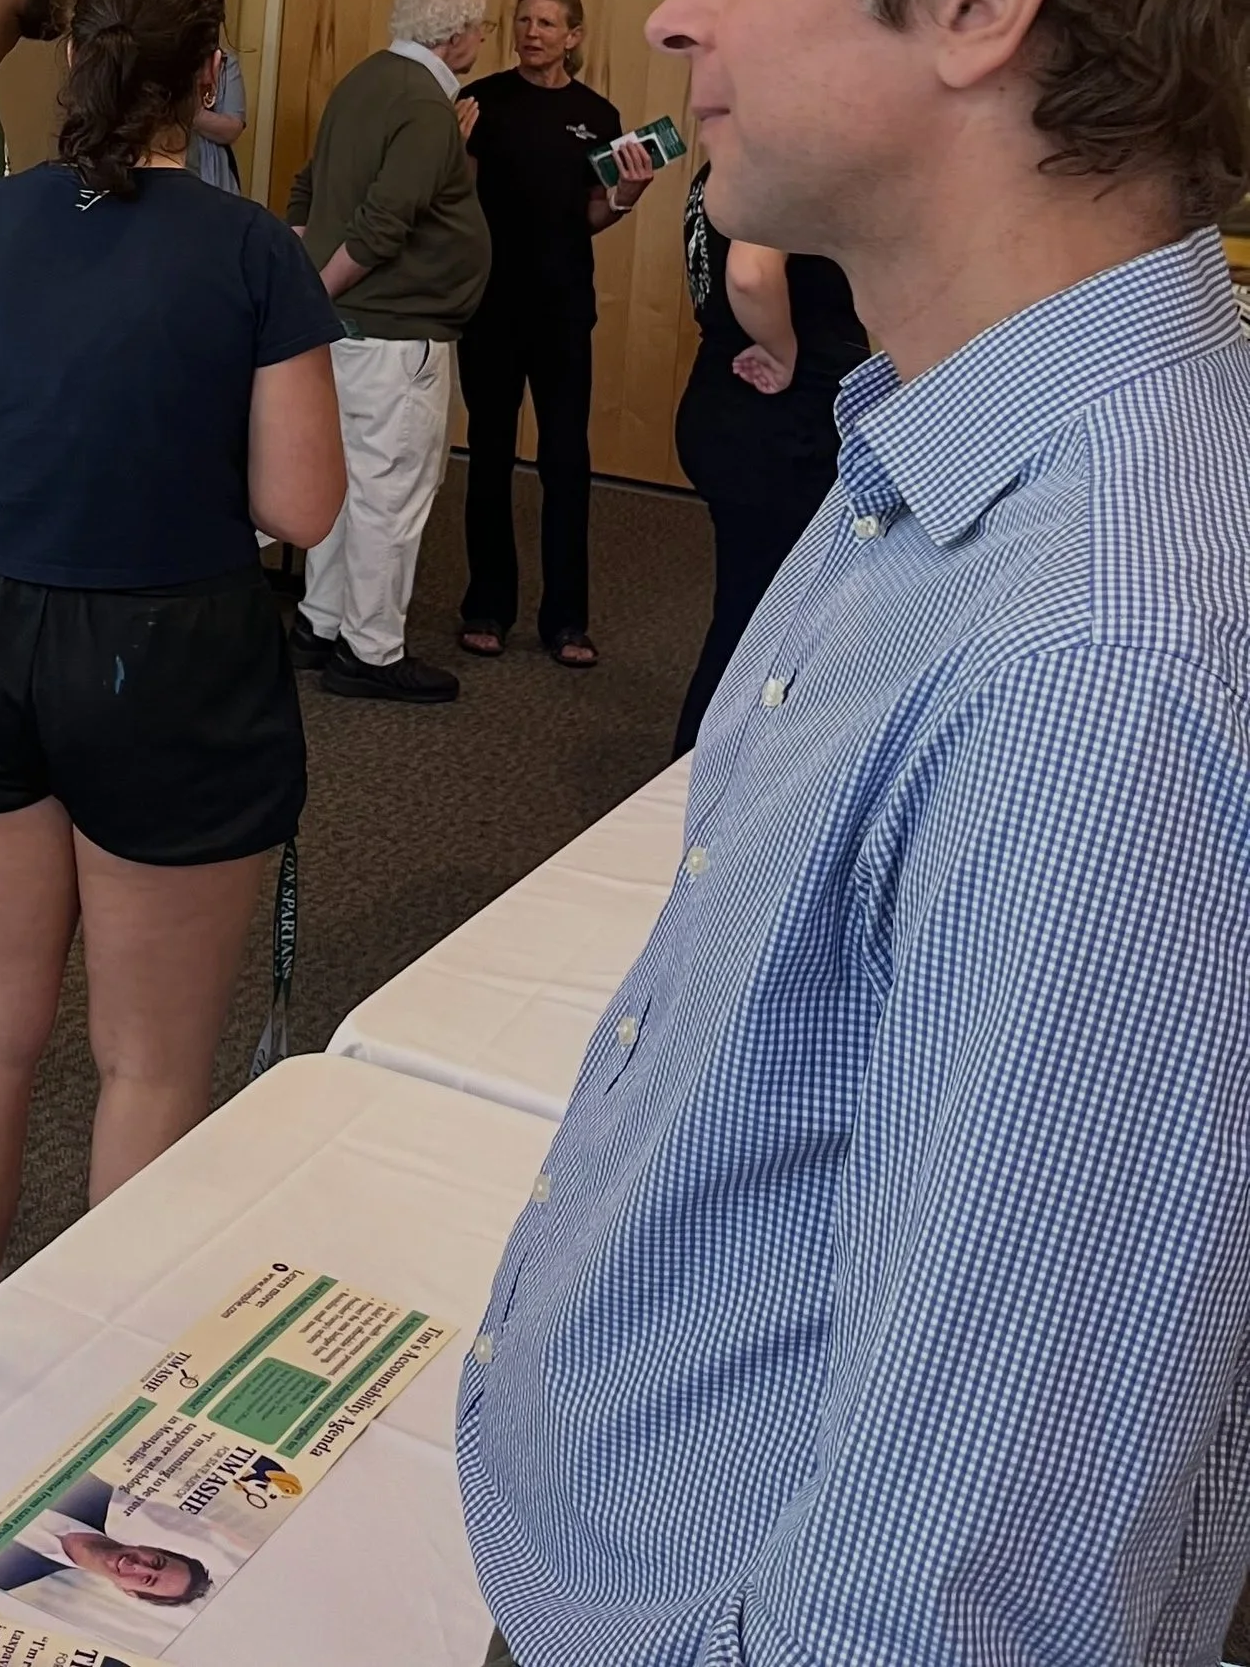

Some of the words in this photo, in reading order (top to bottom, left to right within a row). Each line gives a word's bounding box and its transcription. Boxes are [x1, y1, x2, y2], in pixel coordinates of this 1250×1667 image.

[281, 887, 296, 981] SPARTANS
[275, 1268, 305, 1289] Learn
[254, 1287, 281, 1308] more:
[409, 1326, 444, 1351] Tim's
[166, 1351, 192, 1369] TIM
[142, 1366, 173, 1392] ASHE
[344, 1349, 419, 1416] Accountability
[166, 1414, 183, 1425] in
[159, 1422, 197, 1456] taxpayer
[309, 1414, 355, 1457] Agenda
[158, 1446, 196, 1479] running
[212, 1445, 230, 1459] FOR
[216, 1445, 257, 1476] TIM
[117, 1455, 164, 1495] watchdog
[196, 1456, 218, 1475] STATE
[141, 1485, 160, 1498] be
[152, 1476, 166, 1487] to
[172, 1472, 202, 1499] AUDITOR
[178, 1471, 227, 1515] ASHE
[122, 1494, 146, 1517] your
